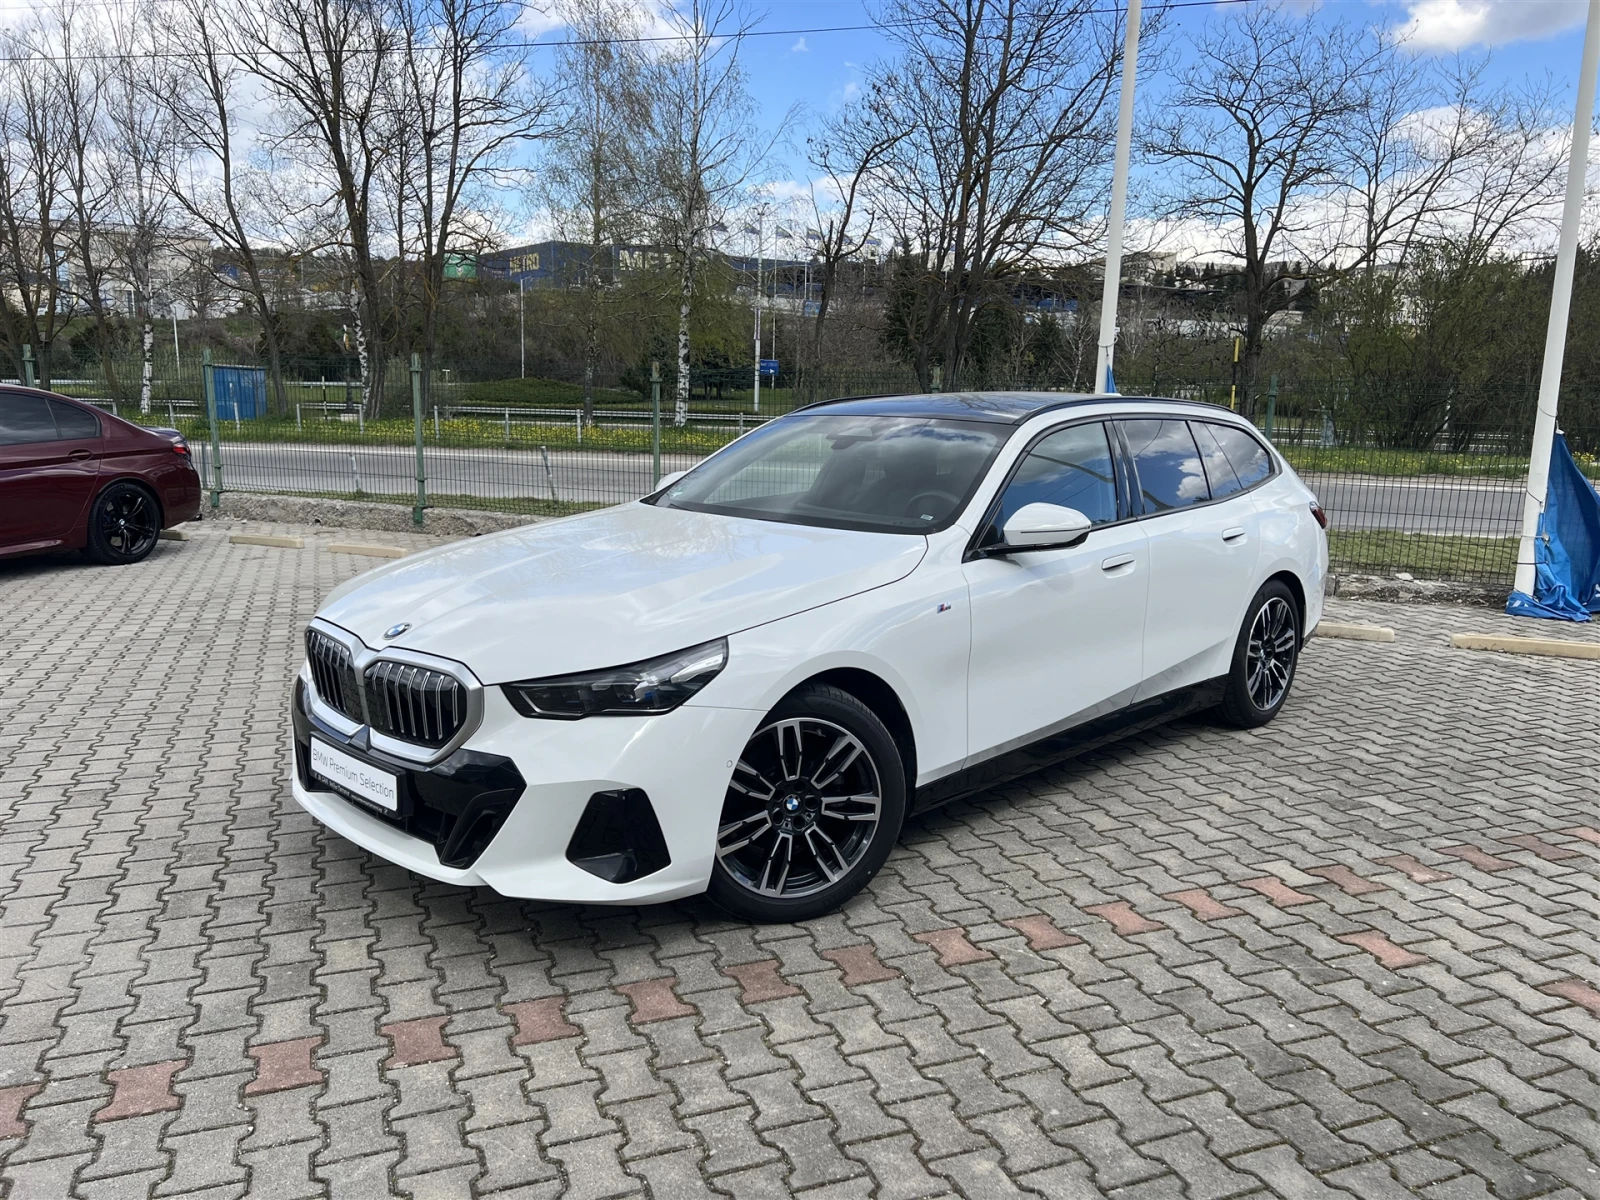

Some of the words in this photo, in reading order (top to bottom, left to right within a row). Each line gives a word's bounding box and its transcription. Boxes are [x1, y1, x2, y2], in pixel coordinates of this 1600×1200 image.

[510, 253, 539, 273] METRO
[313, 748, 329, 767] BMW
[329, 757, 358, 783] Premium
[360, 772, 395, 799] Selection
